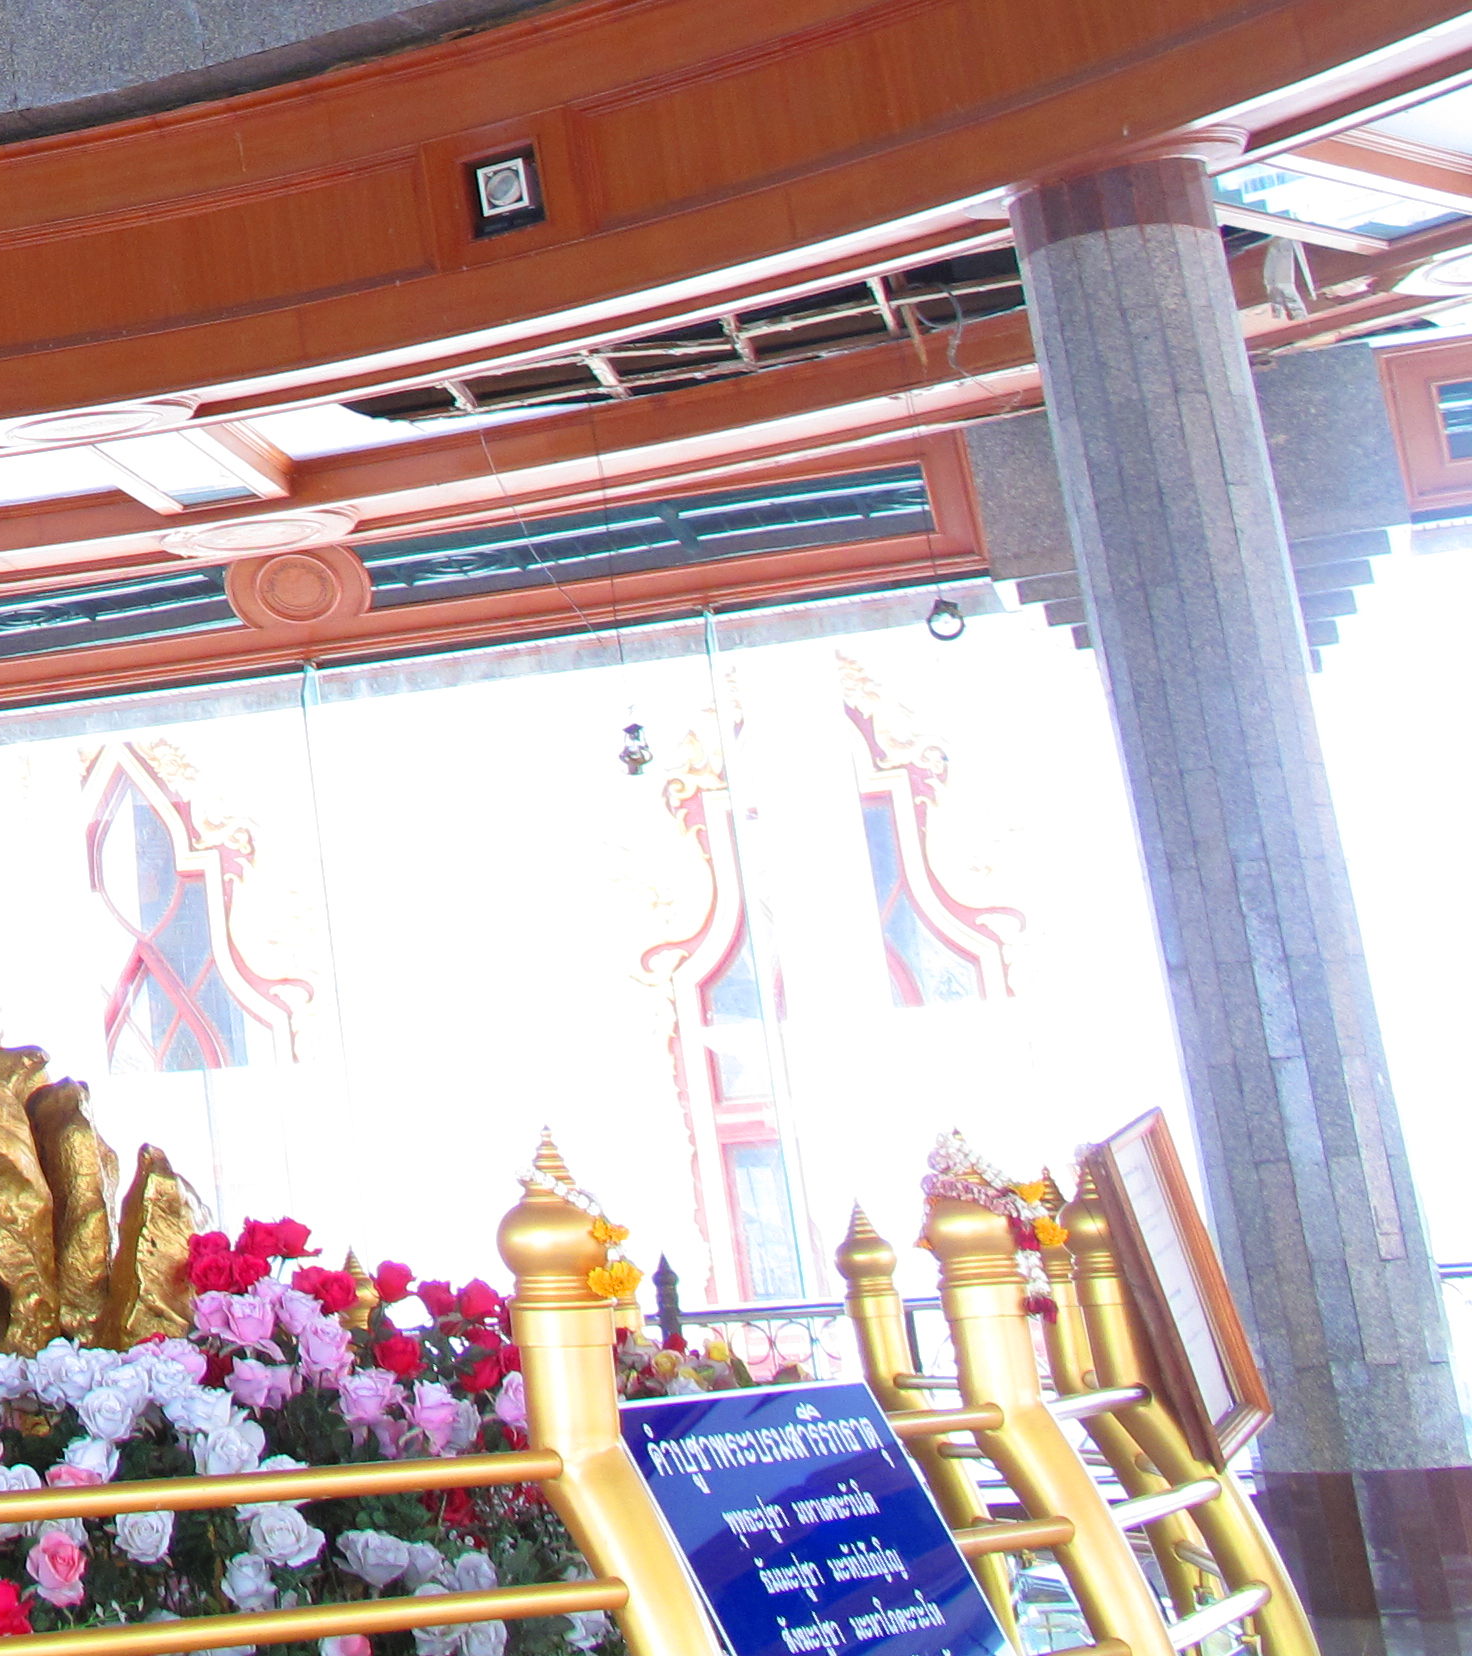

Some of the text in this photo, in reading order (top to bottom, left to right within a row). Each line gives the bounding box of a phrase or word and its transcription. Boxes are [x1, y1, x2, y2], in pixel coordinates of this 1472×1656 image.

[641, 1402, 895, 1494] คำบูชาพระบรมสารีริกธาตุ
